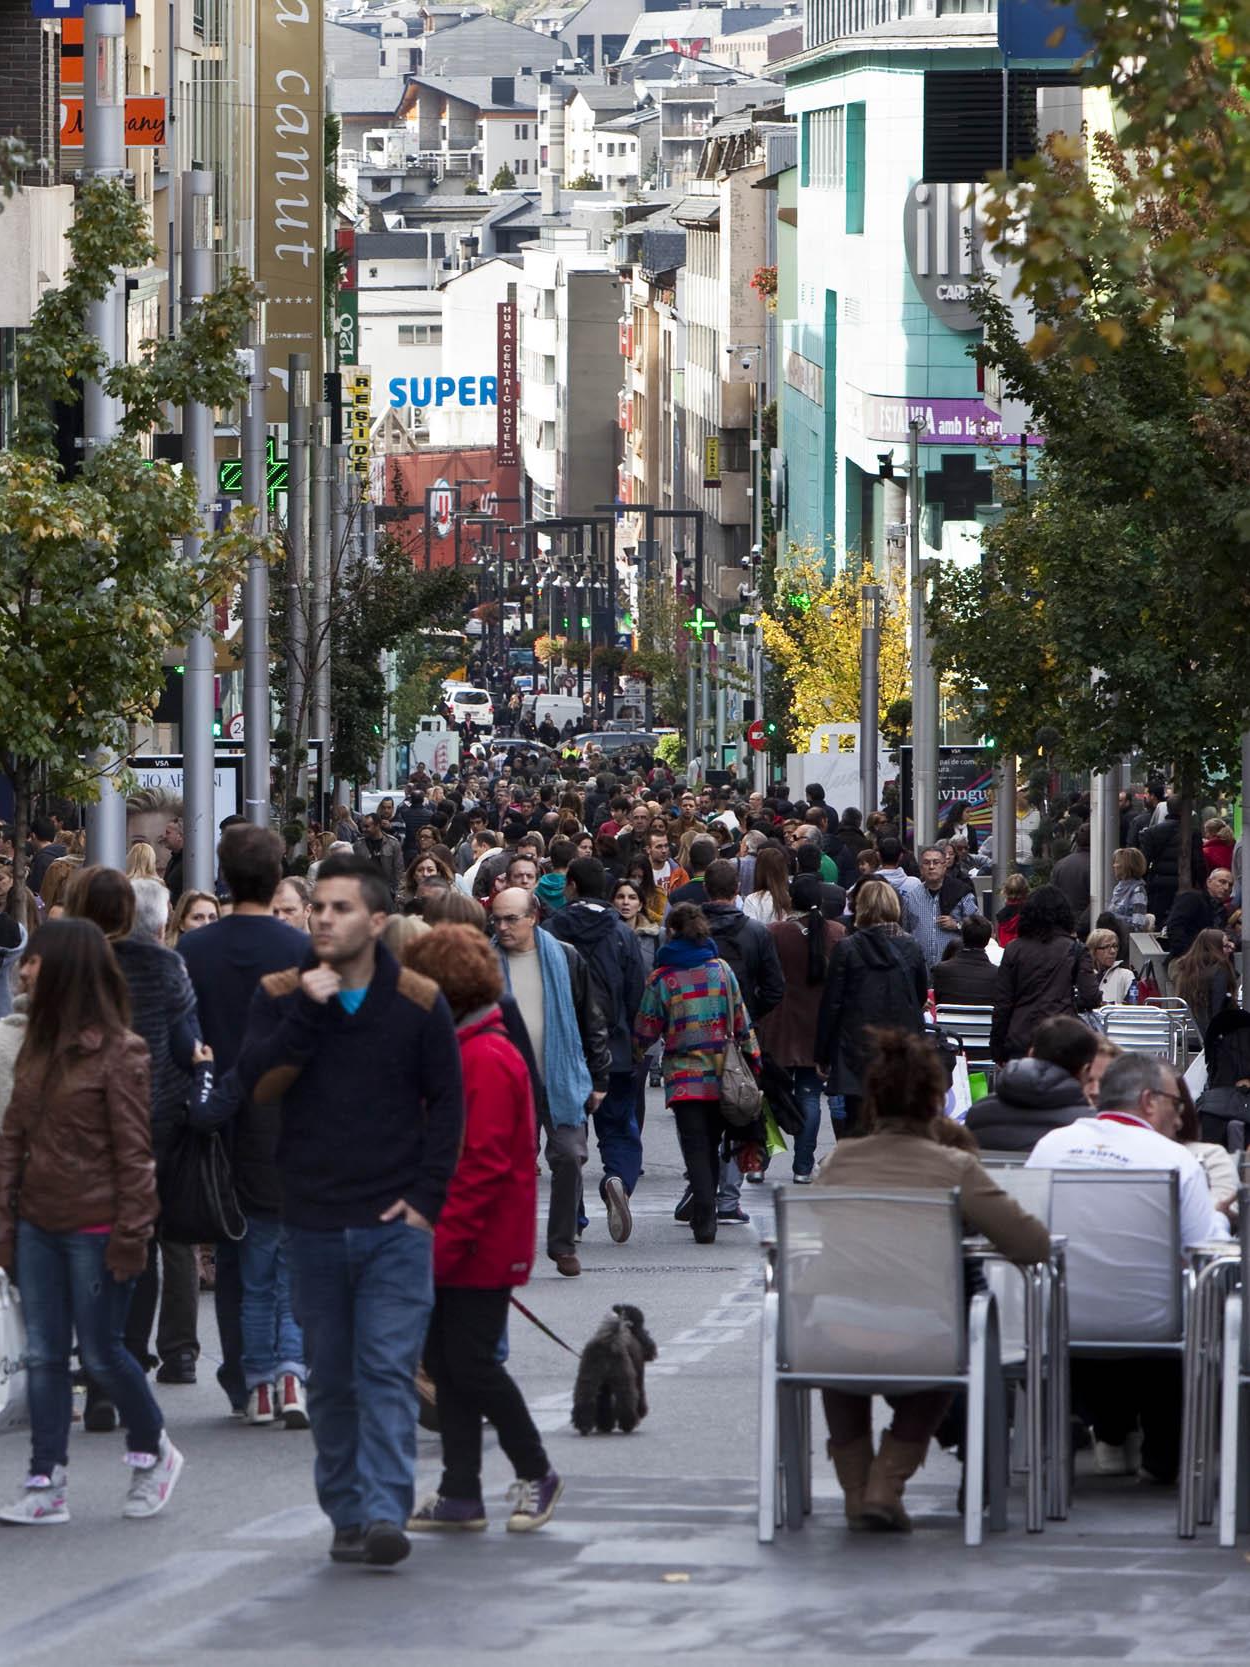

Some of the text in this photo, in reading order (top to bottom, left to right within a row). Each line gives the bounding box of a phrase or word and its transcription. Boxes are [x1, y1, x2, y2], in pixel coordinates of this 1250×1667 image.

[275, 69, 316, 268] canut
[503, 306, 511, 339] HUSA
[388, 375, 498, 409] SUPER
[503, 409, 511, 449] HOTEL
[880, 406, 935, 435] ESTALVIA
[938, 418, 962, 436] amb
[965, 416, 976, 436] la
